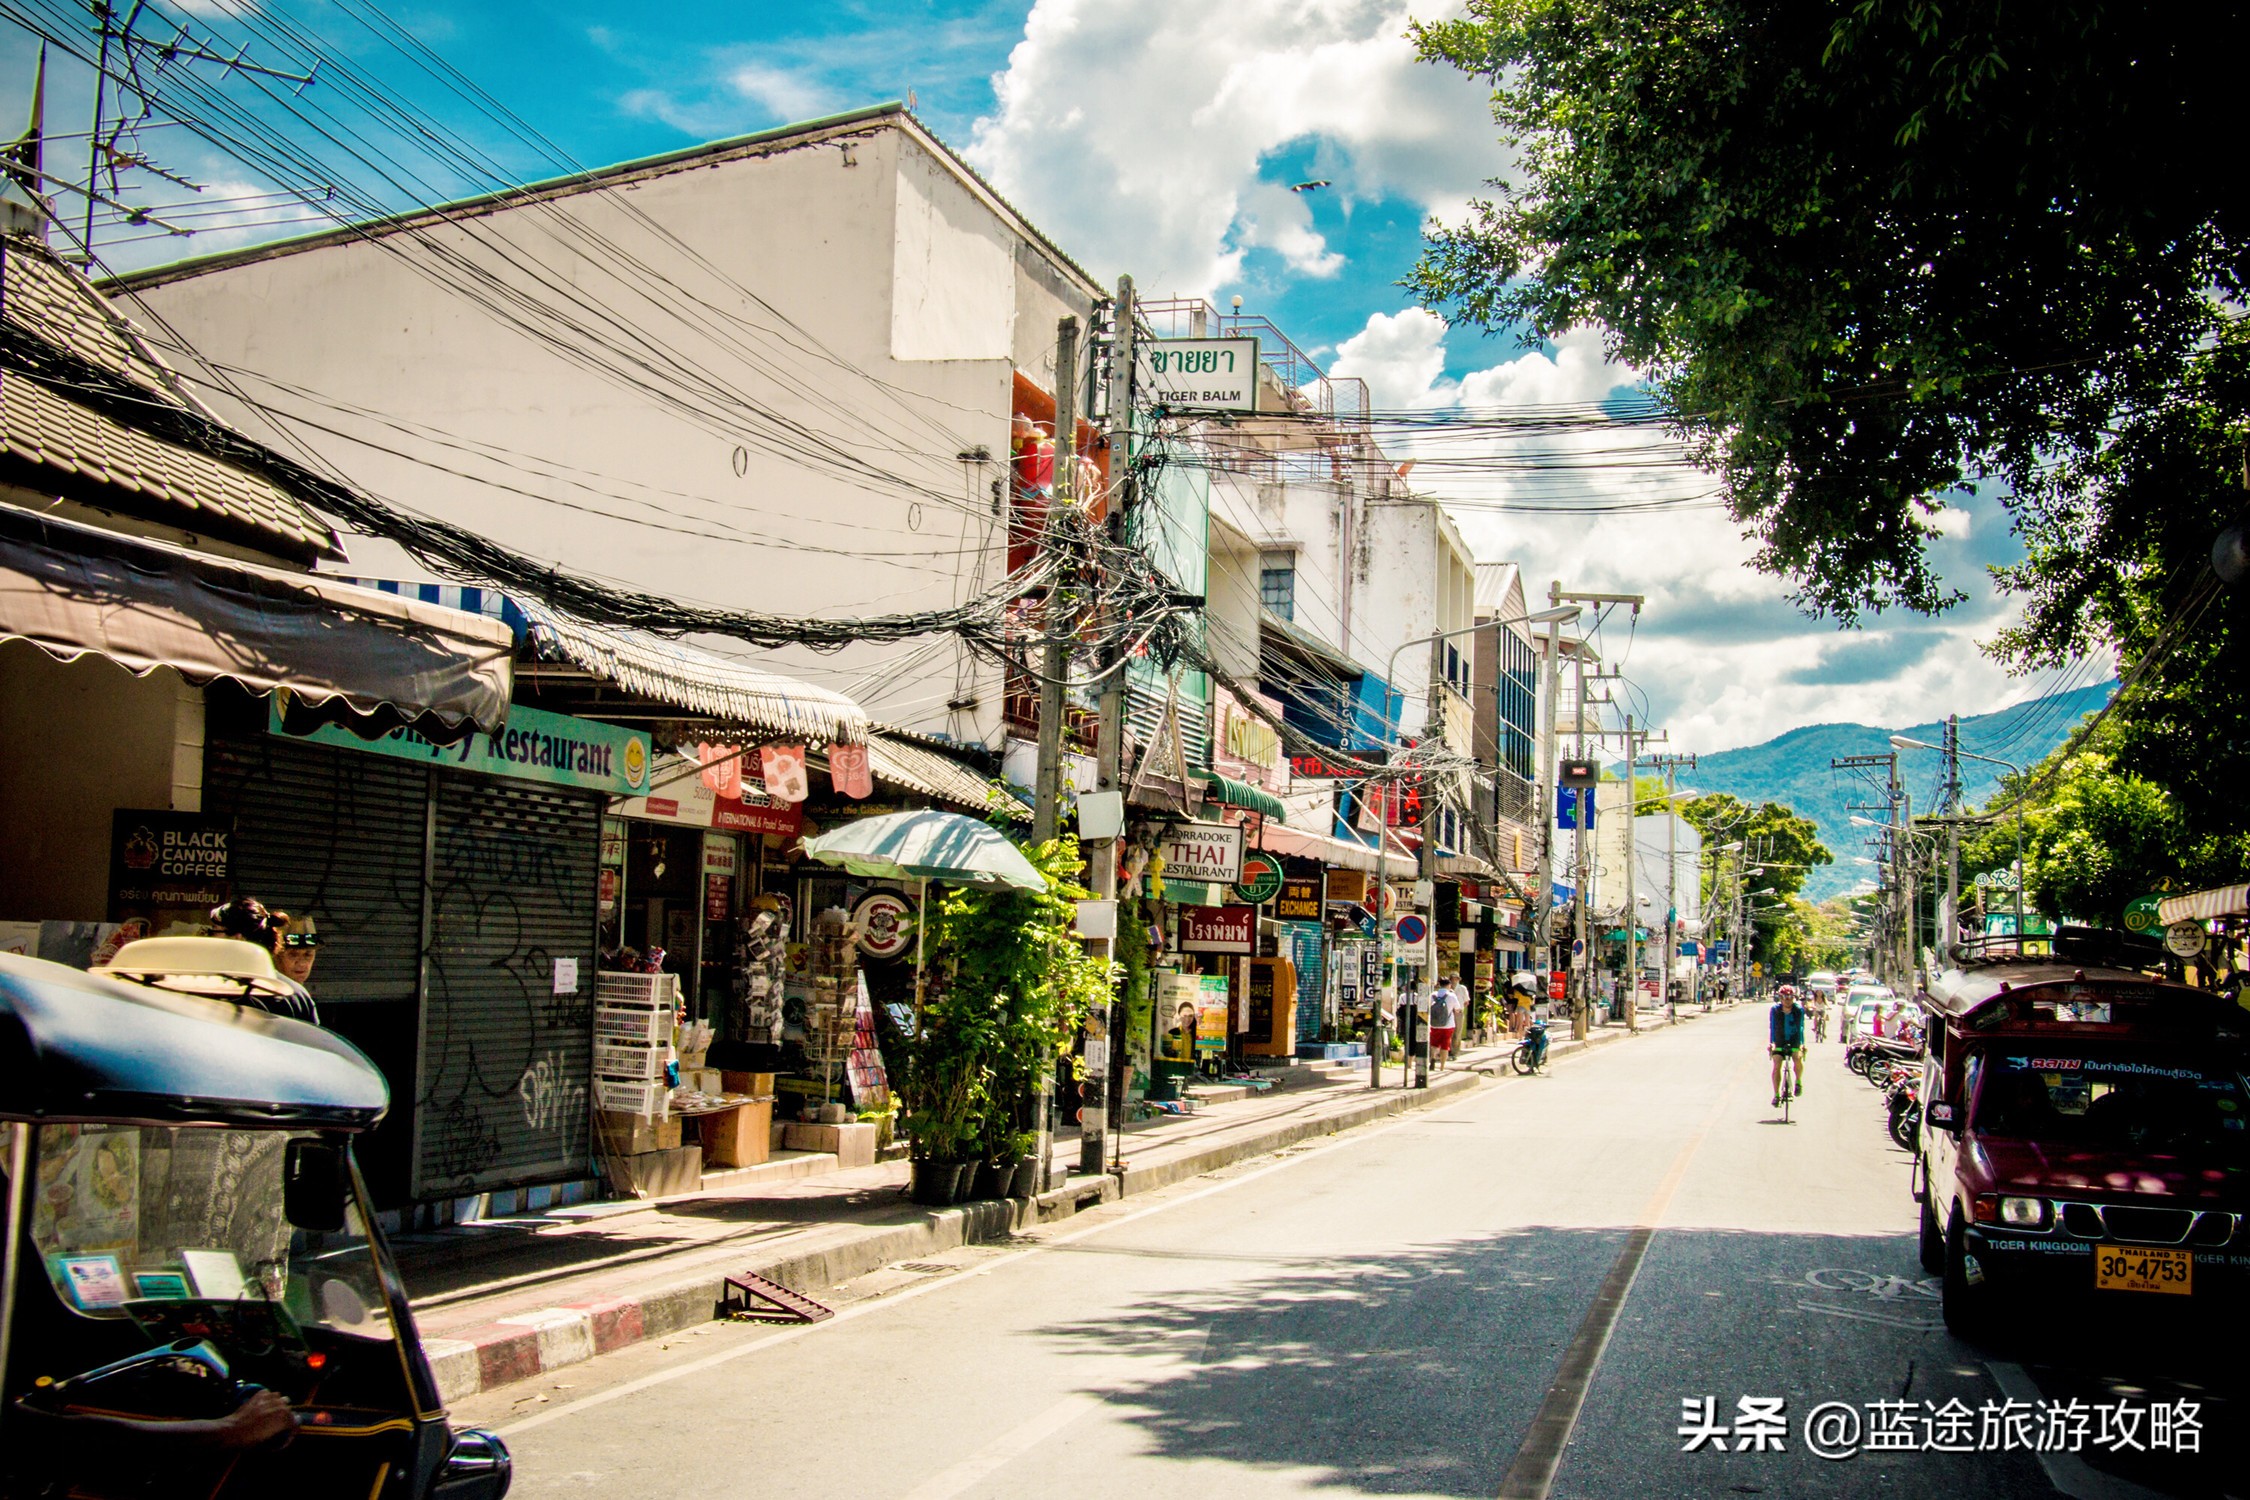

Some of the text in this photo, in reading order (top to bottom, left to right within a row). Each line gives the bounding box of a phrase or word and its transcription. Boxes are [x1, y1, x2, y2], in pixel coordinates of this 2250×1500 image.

[1153, 349, 1235, 374] ขายยา
[1160, 390, 1241, 401] TIGER BALM
[842, 804, 858, 814] the
[860, 803, 894, 815] Gibbon
[718, 812, 794, 832] INTERNATIONAL & Postal Service
[163, 831, 228, 848] BLACK
[1173, 829, 1232, 843] ORRADOKE
[162, 848, 228, 863] CANYON
[1169, 843, 1225, 865] THAI
[161, 862, 226, 877] COFFEE
[1280, 900, 1319, 917] EXCHANGE
[1181, 912, 1250, 941] โรงพิมพ์
[1365, 952, 1376, 998] DRUG
[1250, 983, 1272, 997] HANGE
[1343, 987, 1356, 999] ยา
[2032, 1058, 2082, 1070] ฉลาม
[1988, 1240, 2091, 1252] TIGER KINGDOM
[2119, 1249, 2171, 1259] THAILAND
[2194, 1254, 2250, 1265] IGER KIN
[2102, 1256, 2187, 1282] 30-4753
[2127, 1279, 2161, 1291] เชียงใหม่
